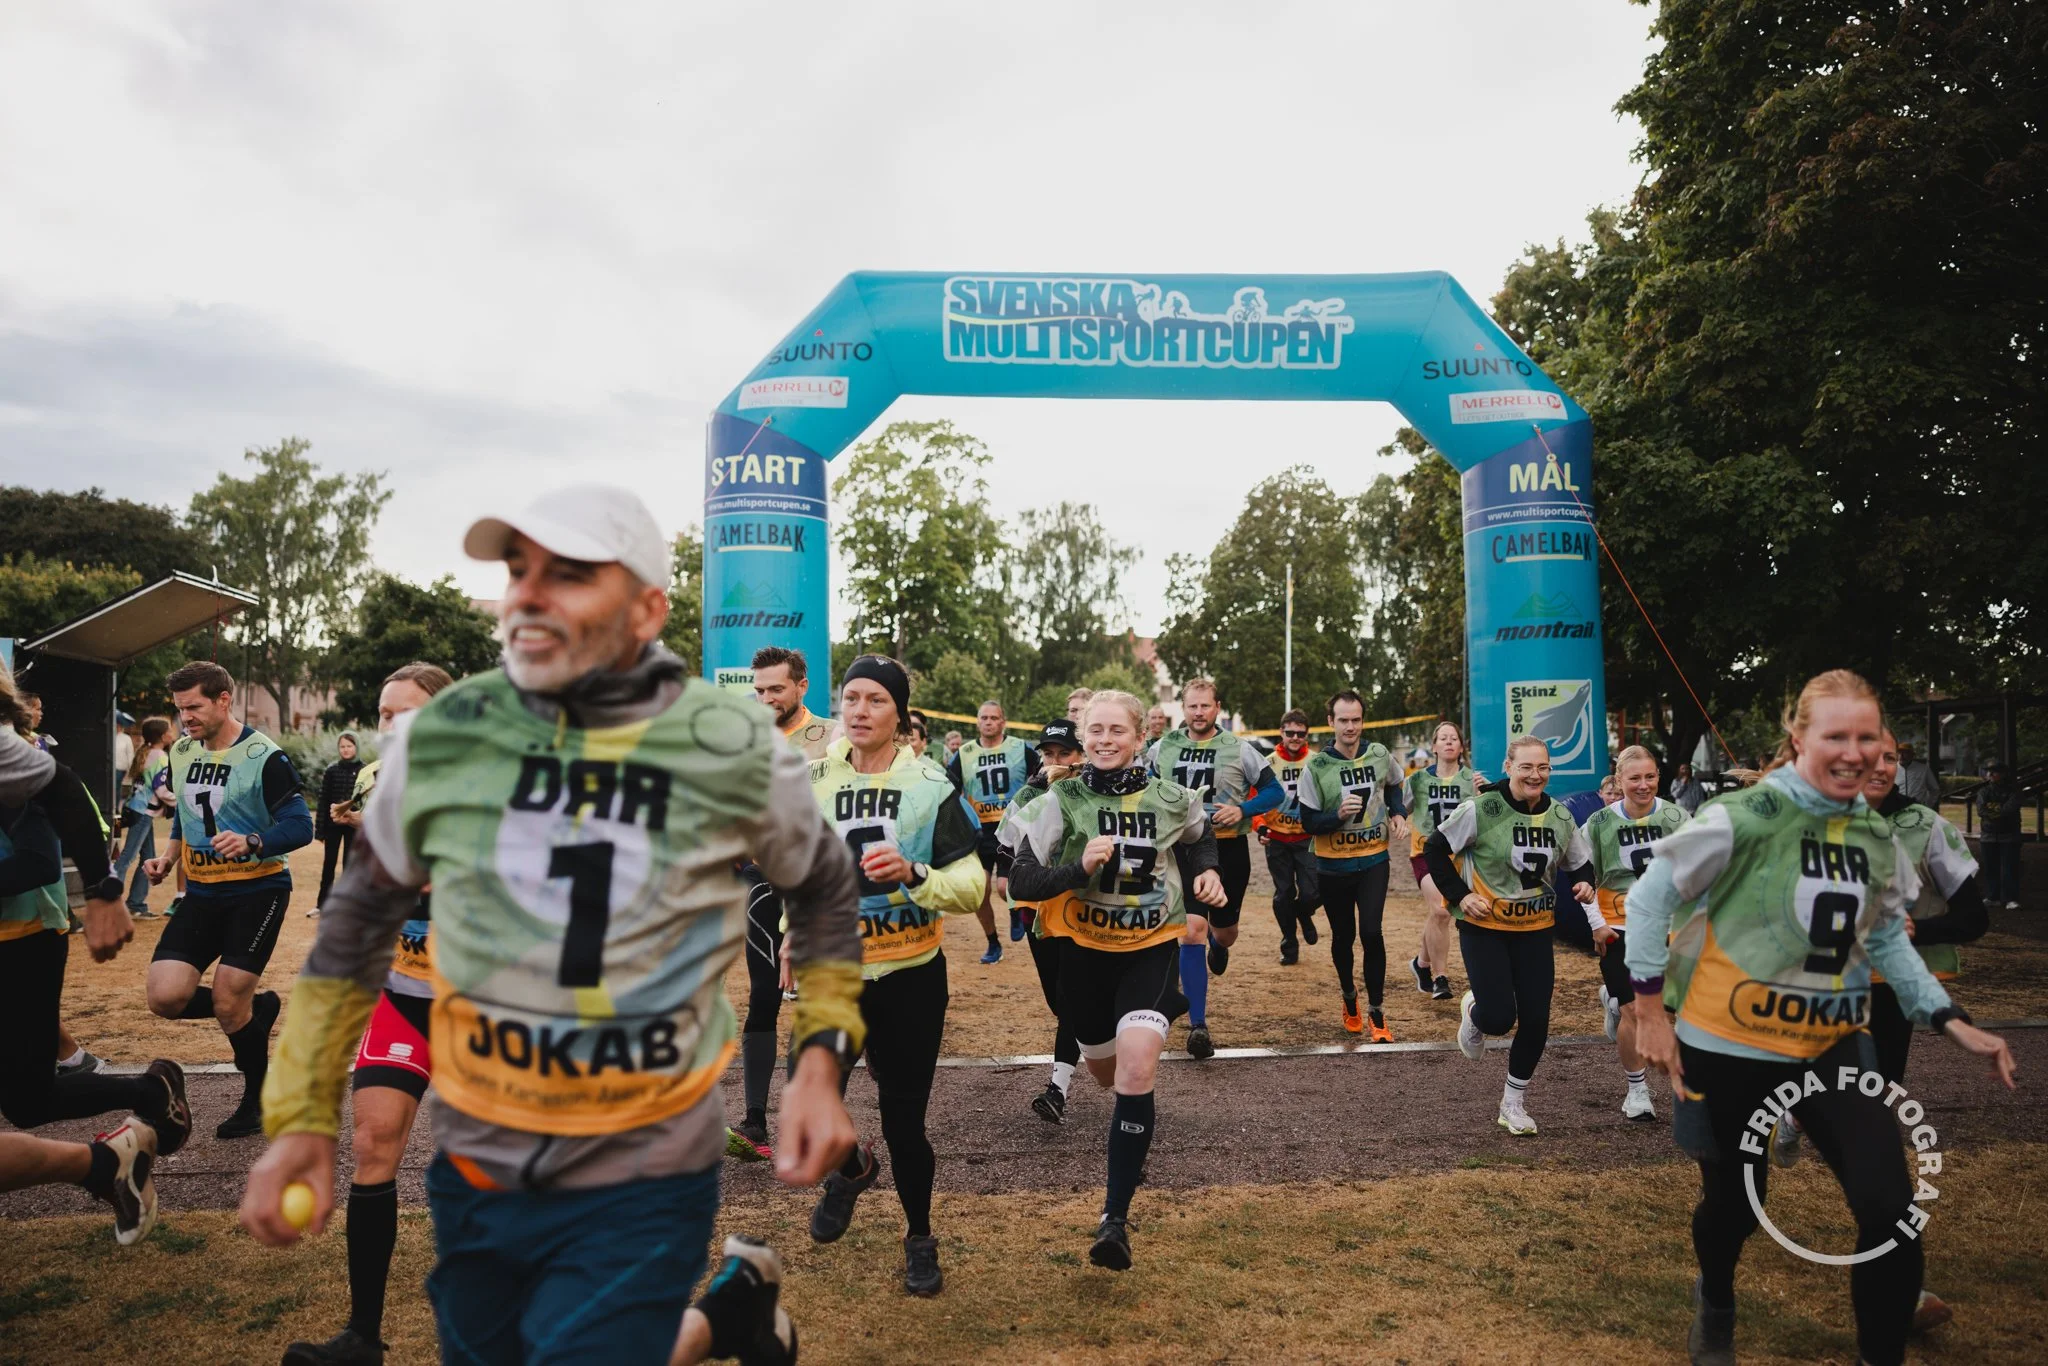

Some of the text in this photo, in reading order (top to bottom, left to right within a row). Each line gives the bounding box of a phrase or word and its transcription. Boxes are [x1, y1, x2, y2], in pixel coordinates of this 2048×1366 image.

[949, 279, 1138, 318] SVENSKA
[768, 341, 873, 366] SUUNTO
[949, 316, 1336, 363] MULTISPORTCUPEN
[1422, 358, 1533, 380] SUUNTO
[751, 382, 829, 395] MERRELL
[1462, 395, 1548, 410] MERRELL
[711, 453, 806, 487] START
[1509, 453, 1580, 494] MÅL
[710, 522, 805, 553] CAMELBAK
[1492, 532, 1593, 563] CAMELBAK
[710, 610, 804, 630] montrail
[1496, 621, 1595, 642] montrail
[718, 672, 755, 684] Skinz
[1511, 685, 1557, 699] Skinz
[1511, 699, 1523, 734] Seal
[186, 758, 232, 787] ÖAR
[509, 743, 673, 831] ÖAR
[976, 767, 1010, 796] 10
[1172, 767, 1217, 804] 14
[1282, 766, 1304, 782] ÖA
[1340, 765, 1377, 787] ÖAR
[835, 784, 902, 822] ÖAR
[1428, 782, 1461, 799] ÖAR
[195, 790, 217, 838] 1
[979, 801, 1011, 814] JOKA
[1278, 815, 1302, 825] JOK
[1350, 787, 1372, 824] 7
[1097, 806, 1157, 840] ÖAR
[1336, 826, 1382, 845] JOKAB
[1513, 821, 1556, 848] ÖAR
[1618, 825, 1662, 847] ÖAR
[1099, 843, 1158, 896] 13
[1520, 852, 1548, 890] 2
[1801, 830, 1870, 885] ÖAR
[547, 840, 615, 988] 1
[1077, 905, 1160, 931] JOKAB
[1502, 896, 1554, 917] JOKAB
[248, 899, 279, 953] SWEDEMOUNT
[1803, 891, 1860, 976] 9
[1129, 1015, 1168, 1029] CRAFT
[468, 1014, 680, 1078] JOKAB
